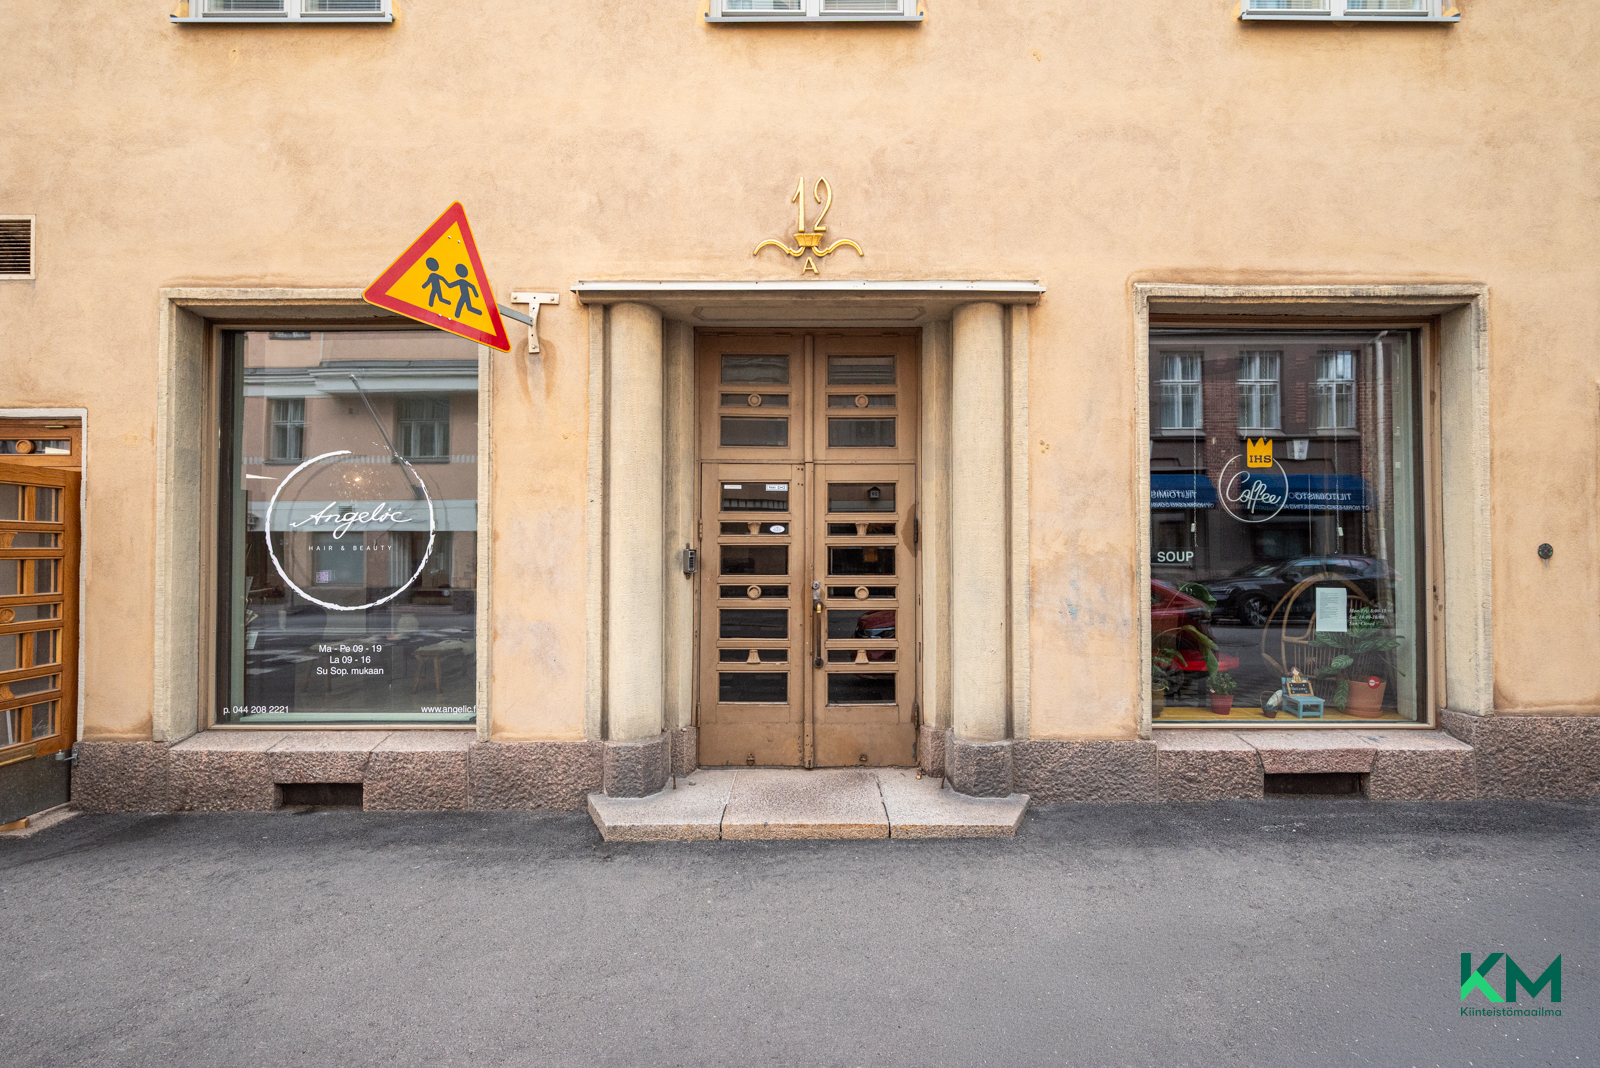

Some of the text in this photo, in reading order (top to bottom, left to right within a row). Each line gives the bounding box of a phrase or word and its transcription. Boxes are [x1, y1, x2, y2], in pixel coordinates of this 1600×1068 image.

[792, 176, 833, 232] 12
[802, 256, 819, 275] A
[1249, 455, 1272, 464] IHS
[1226, 470, 1282, 514] Coffee
[290, 501, 413, 540] Angelic
[1157, 551, 1194, 563] SOUP
[318, 644, 333, 653] Ma
[339, 644, 351, 653] Pe
[352, 644, 364, 653] 09
[371, 644, 382, 653] 19
[329, 656, 341, 664] La
[341, 656, 353, 664] 09
[360, 656, 371, 664] 16
[316, 667, 384, 676] Su Sop. mukaan
[223, 705, 289, 715] p. 044 208 2221
